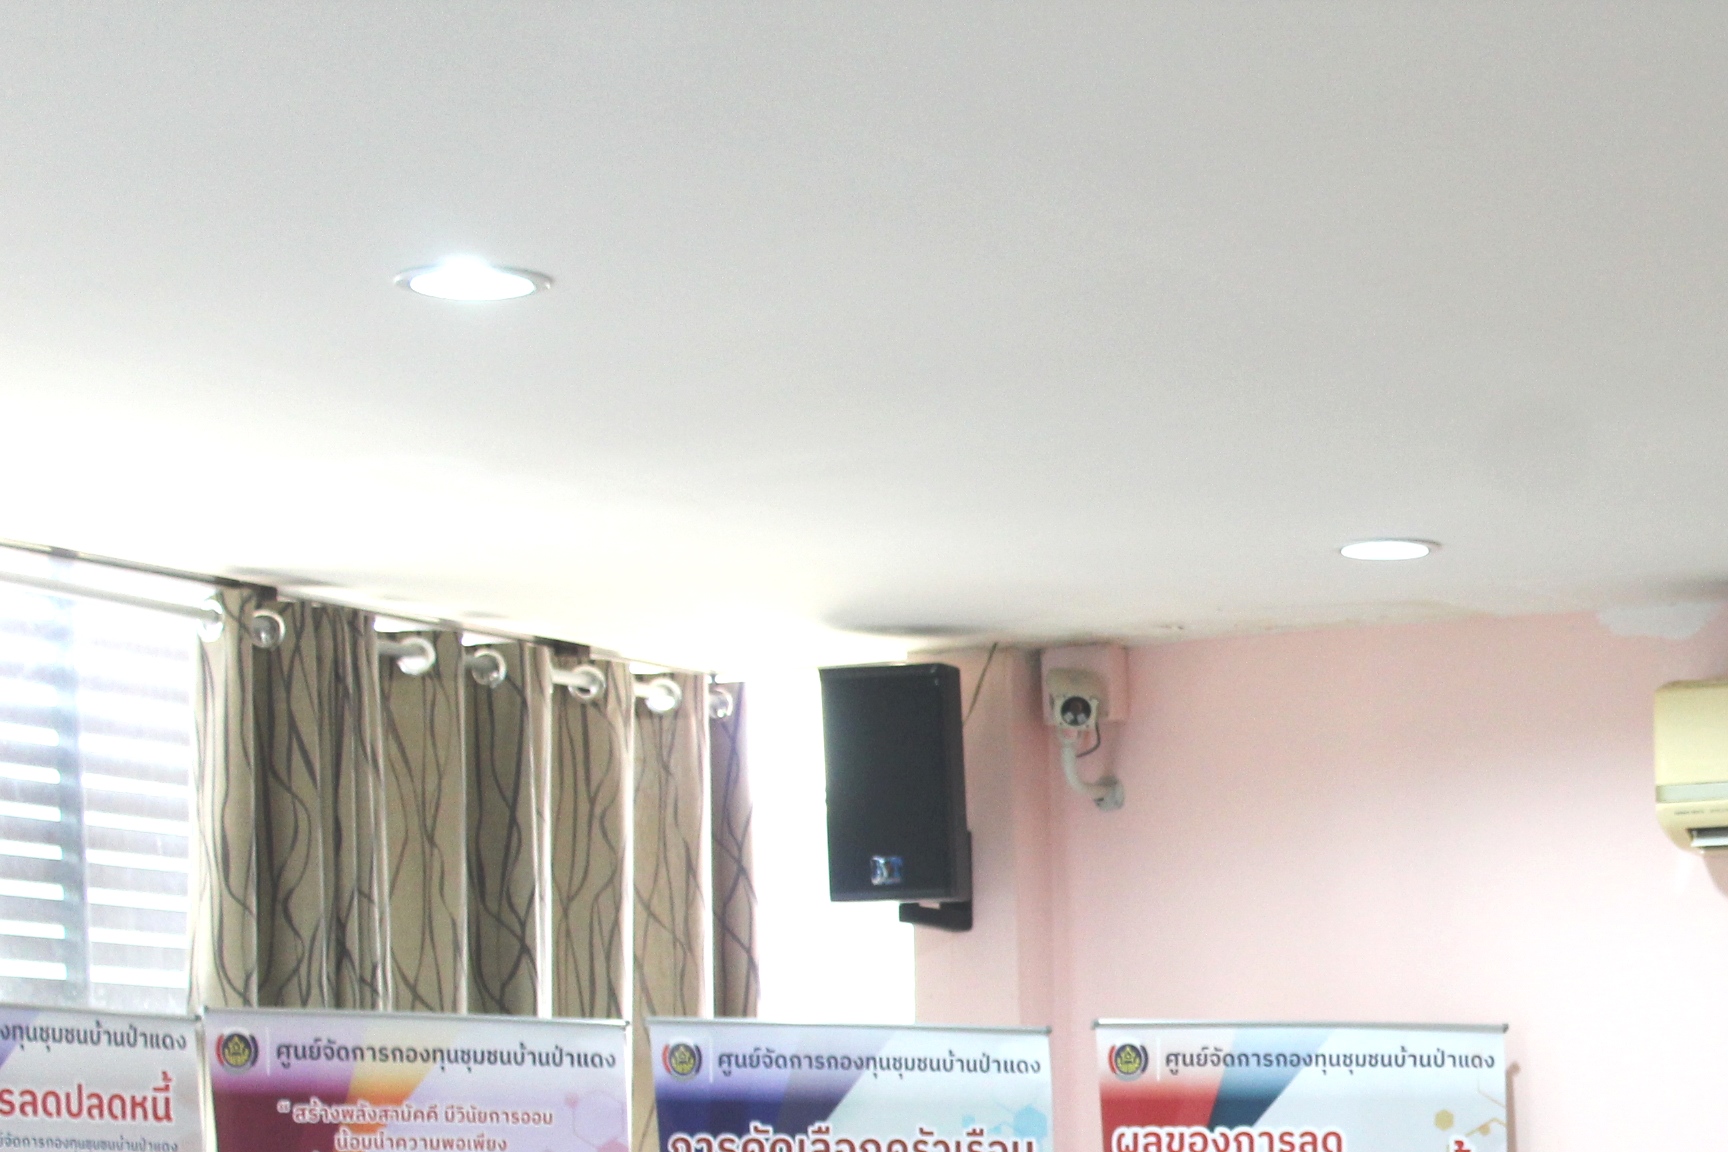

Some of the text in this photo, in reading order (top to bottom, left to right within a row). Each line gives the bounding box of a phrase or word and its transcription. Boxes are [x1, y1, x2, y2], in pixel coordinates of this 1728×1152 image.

[276, 1037, 617, 1073] ศูนย์จัดการกองทุนชุมชนบ้านป่าแดง
[718, 1047, 1041, 1078] ศูนย์จัดการกองทุนชุมชนบ้านป่าแดง
[1165, 1046, 1496, 1075] ศูนย์จัดการกองทุนชุมชนบ้านป่าแดง
